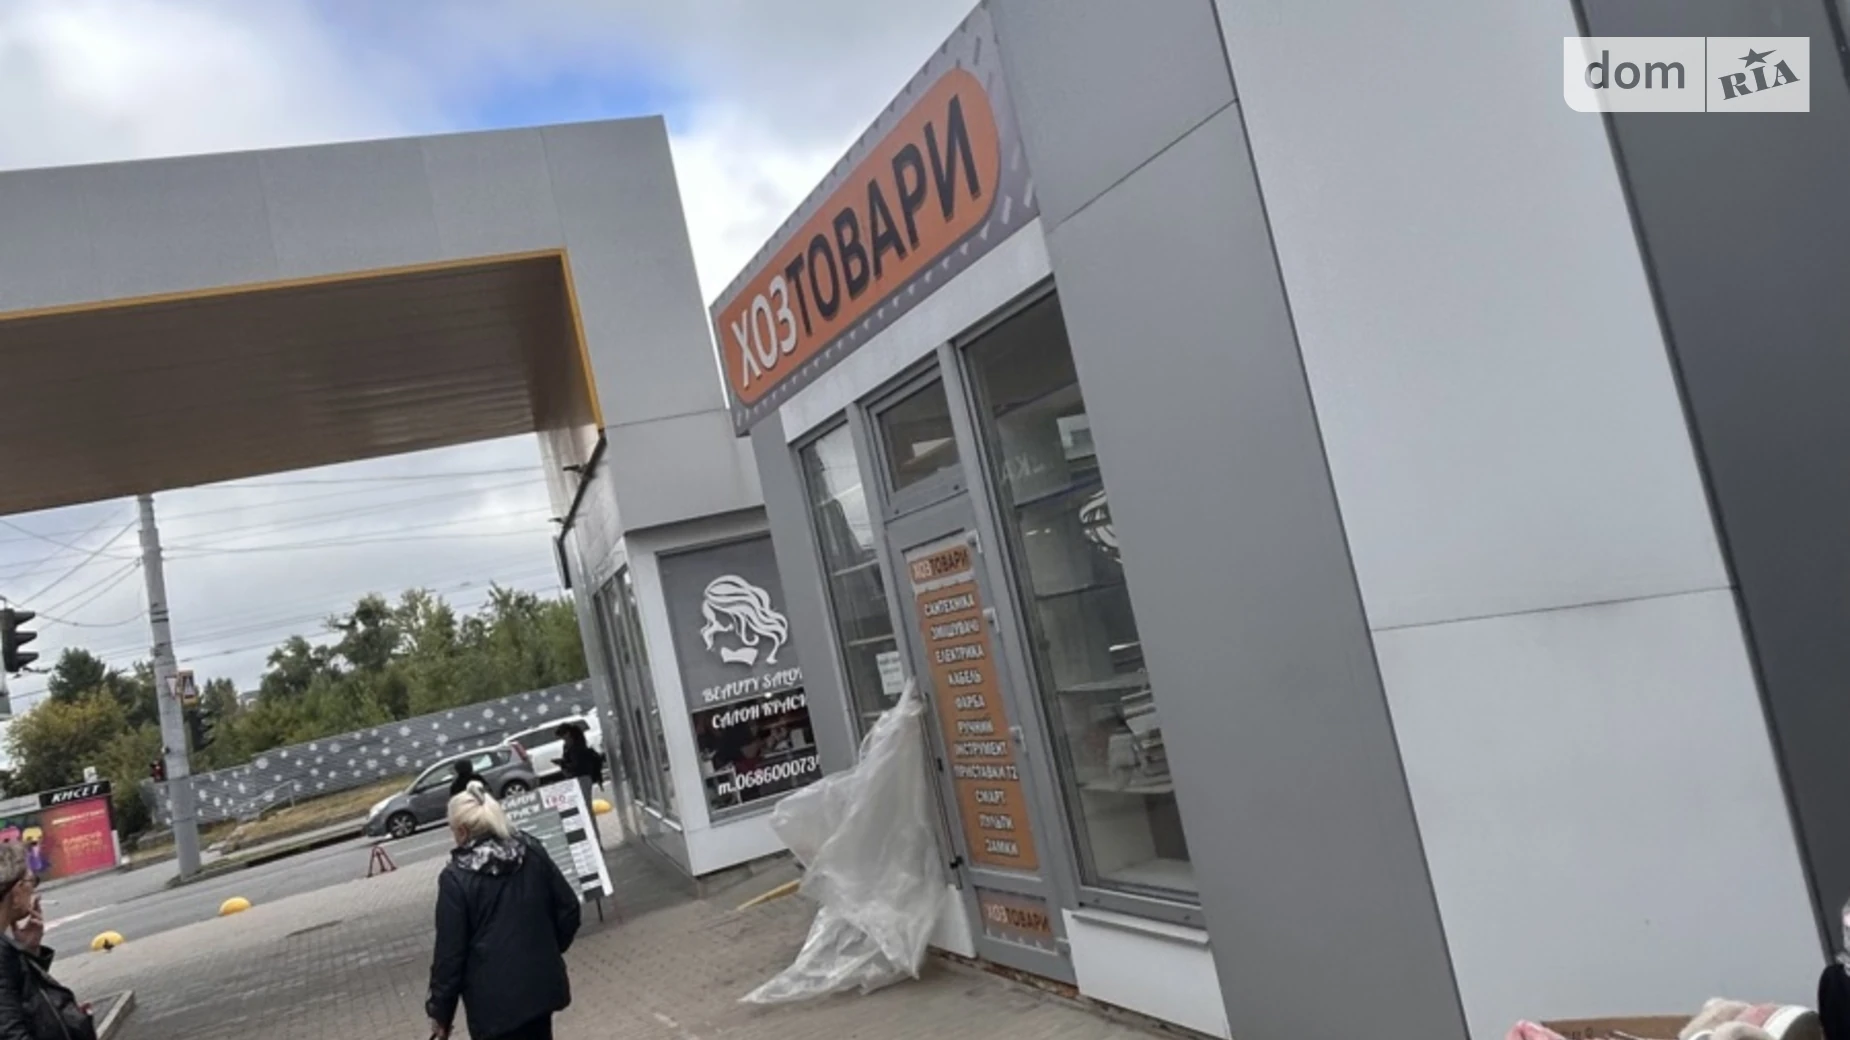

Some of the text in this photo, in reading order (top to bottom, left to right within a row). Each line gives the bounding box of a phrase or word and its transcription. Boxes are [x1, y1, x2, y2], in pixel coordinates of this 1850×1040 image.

[731, 94, 981, 388] ХОЗТОВАРИ
[912, 548, 968, 579] ХОЗТОВАРИ
[935, 644, 985, 664] ЕЛЕКТРИКА
[948, 669, 983, 685] КАБЕЛЬ
[702, 677, 760, 702] BEAUTY
[712, 704, 760, 728] САЛОН
